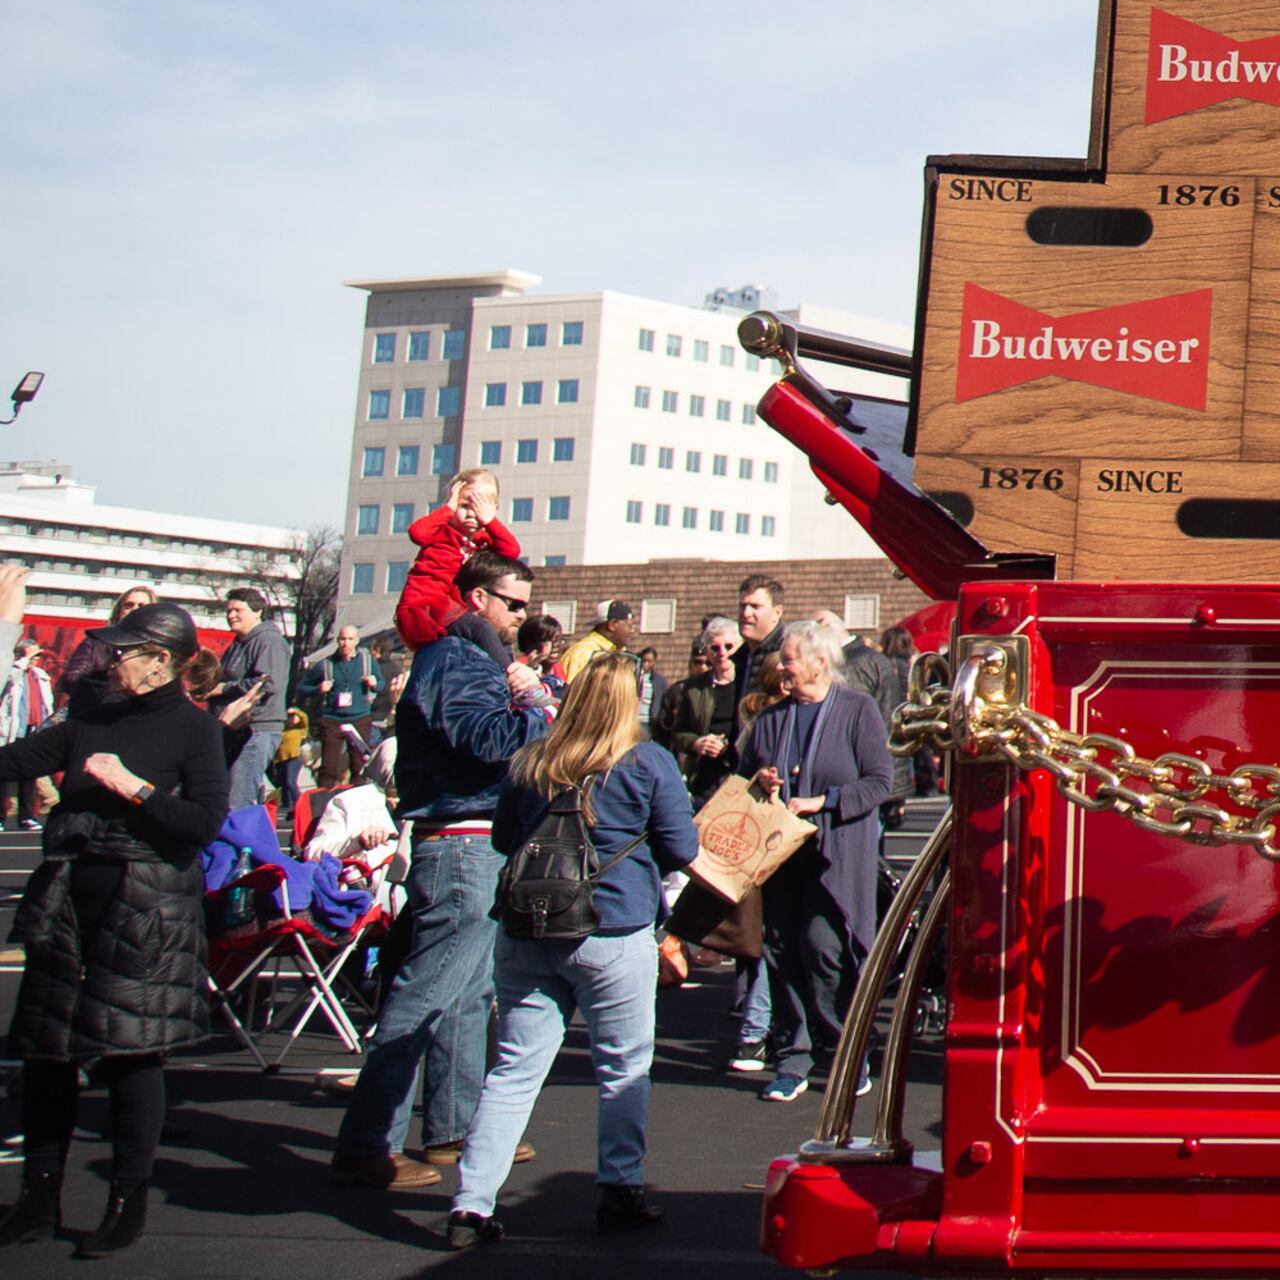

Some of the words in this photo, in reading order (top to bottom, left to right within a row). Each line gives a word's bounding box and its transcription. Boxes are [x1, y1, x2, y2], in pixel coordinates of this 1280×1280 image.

[949, 178, 1033, 202] SINCE
[1157, 184, 1240, 207] 1876
[969, 319, 1200, 364] Budweiser
[979, 466, 1064, 492] 1876
[1097, 469, 1183, 494] SINCE
[709, 832, 752, 854] TRADER
